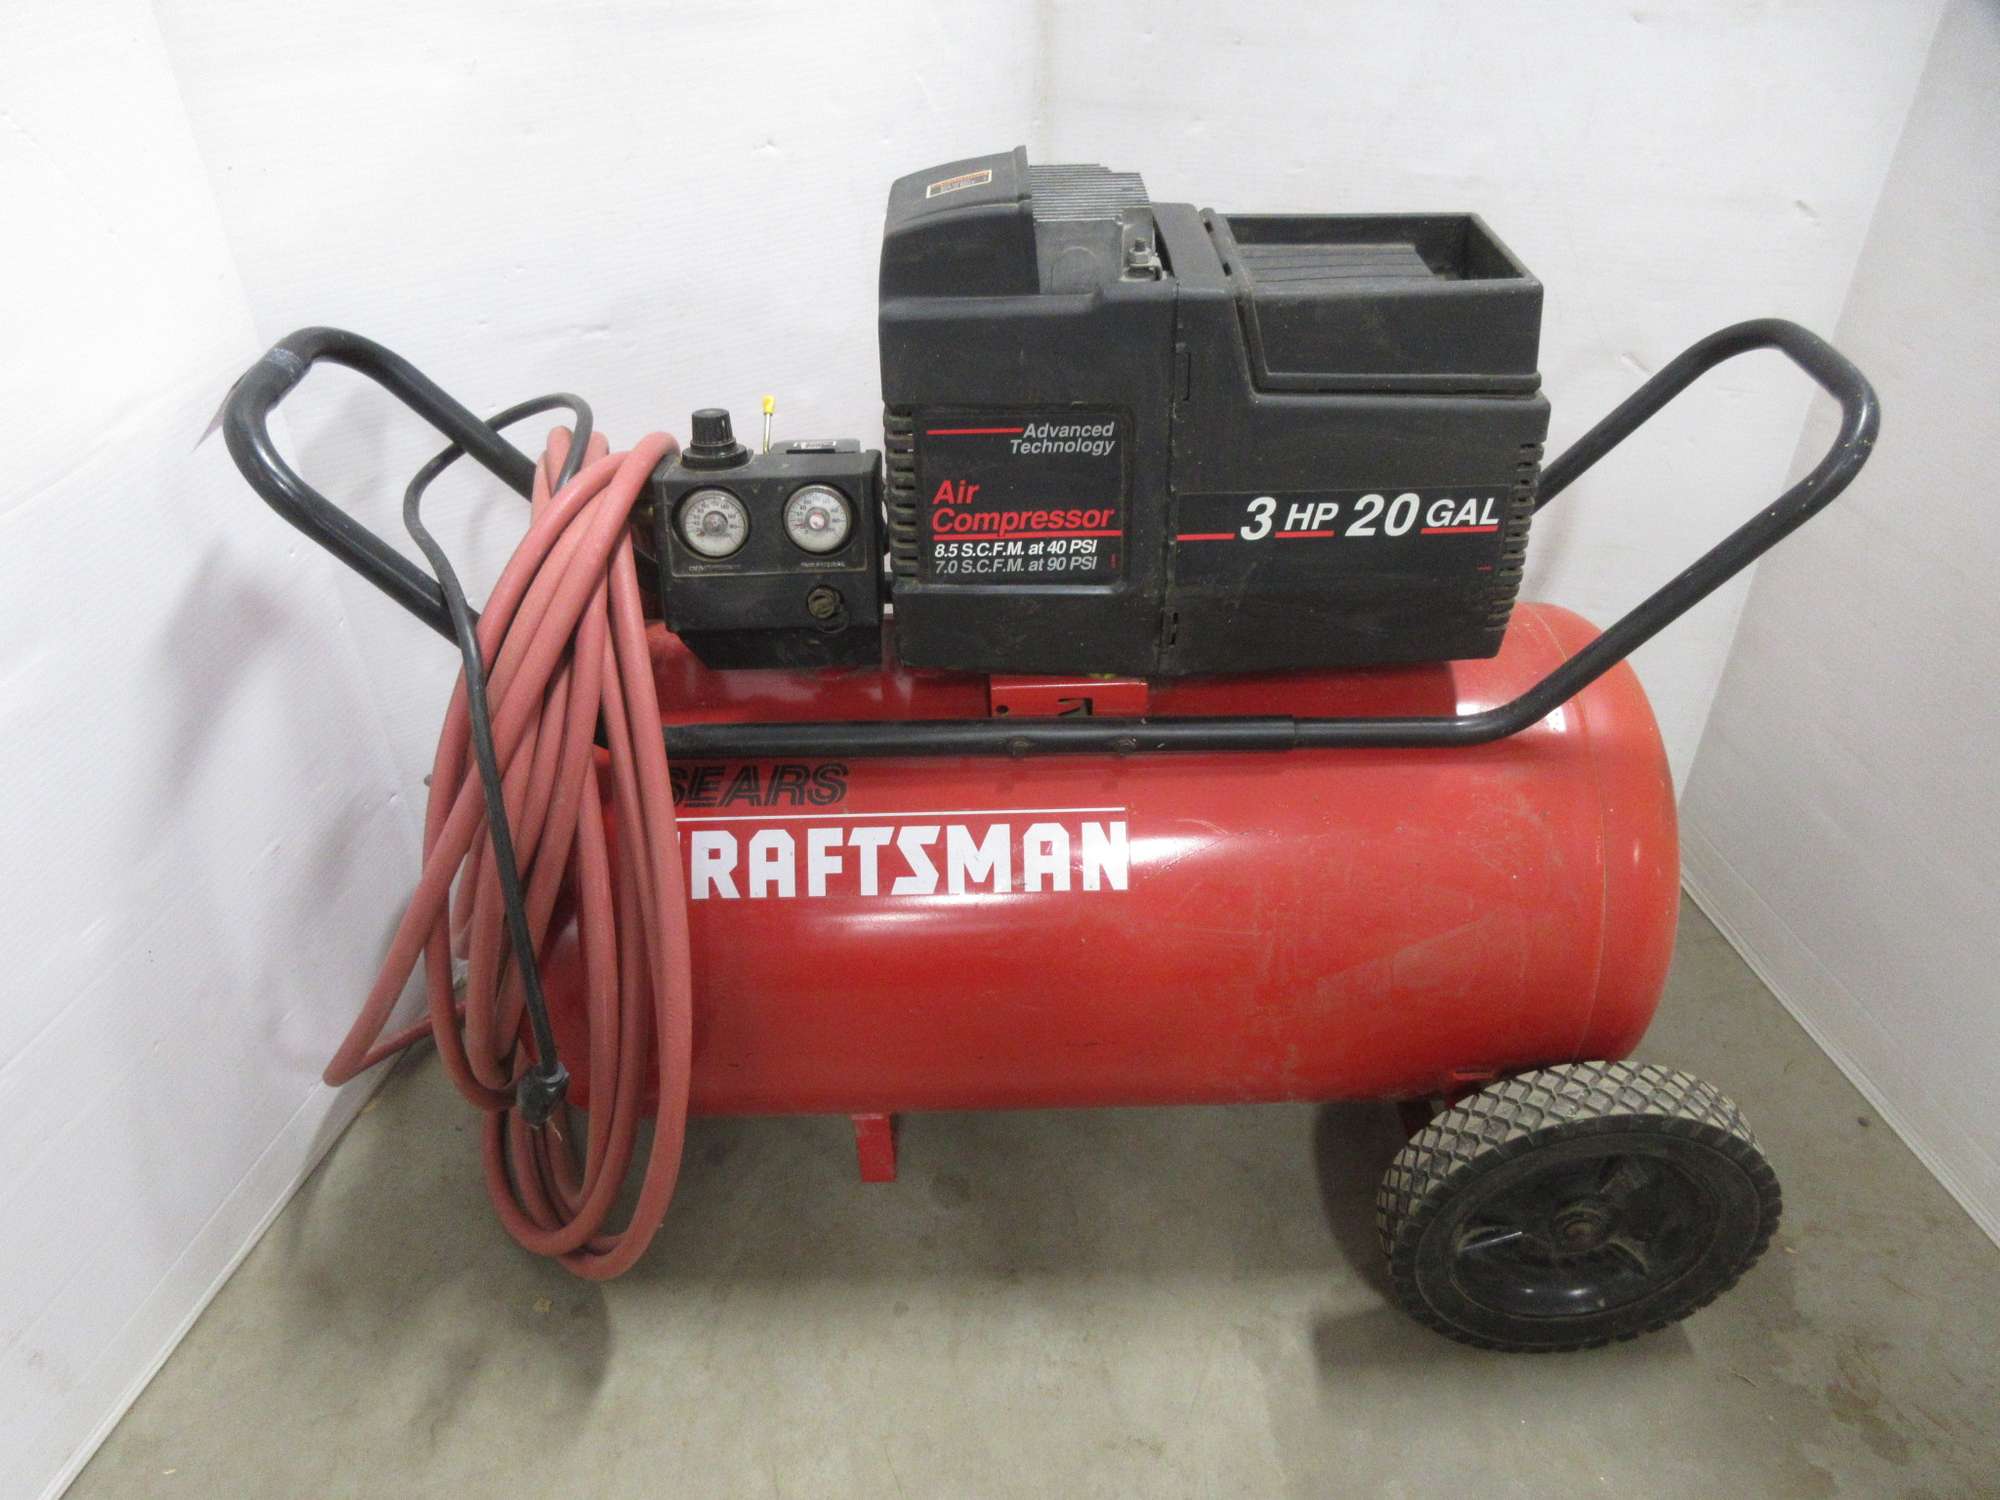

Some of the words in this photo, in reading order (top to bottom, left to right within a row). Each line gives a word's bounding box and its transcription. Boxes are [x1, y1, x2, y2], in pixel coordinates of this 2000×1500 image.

[1022, 421, 1115, 439] Advanced
[1010, 438, 1116, 456] Technology
[932, 480, 980, 505] Air
[932, 508, 1115, 537] Compressor
[1239, 496, 1277, 541] 3
[1284, 503, 1340, 532] HP
[1344, 492, 1420, 538] 20
[1426, 497, 1500, 528] GAL
[934, 543, 958, 558] 8.5
[961, 542, 1025, 558] S.C.F.M.
[1029, 542, 1044, 555] at
[1047, 541, 1067, 555] 40
[1069, 539, 1098, 554] PSI
[935, 560, 958, 575] 7.0
[961, 558, 1025, 574] S.C.F.M.
[1029, 558, 1044, 572] at
[1047, 557, 1067, 571] 90
[1069, 556, 1098, 571] PSI
[677, 821, 1129, 900] RAFTSMAN
